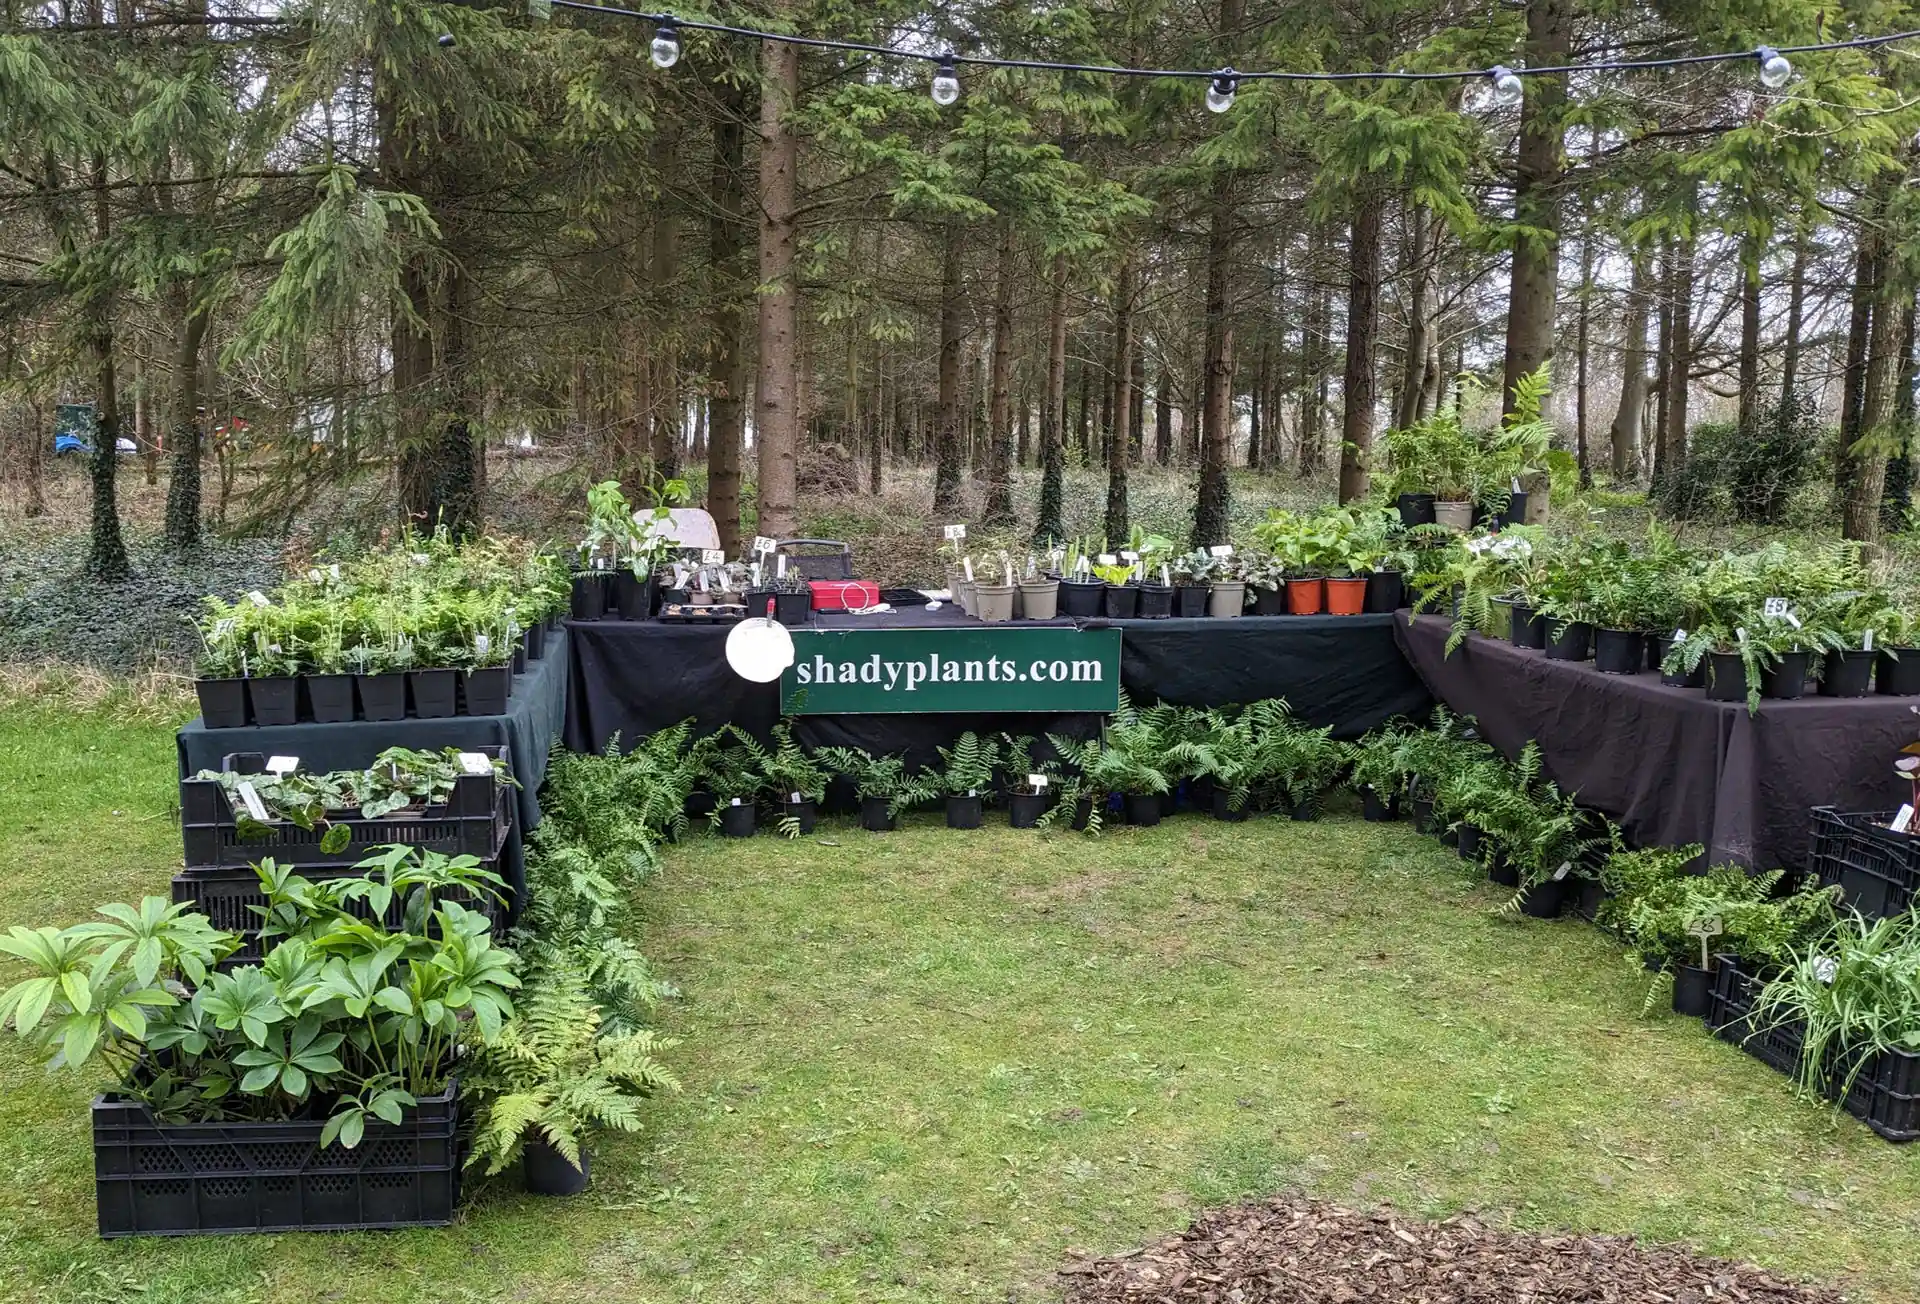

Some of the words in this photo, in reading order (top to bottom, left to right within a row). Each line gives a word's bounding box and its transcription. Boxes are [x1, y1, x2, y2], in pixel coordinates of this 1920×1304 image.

[756, 537, 772, 550] £6
[703, 550, 721, 562] £4
[796, 653, 1104, 691] shadyplants.com
